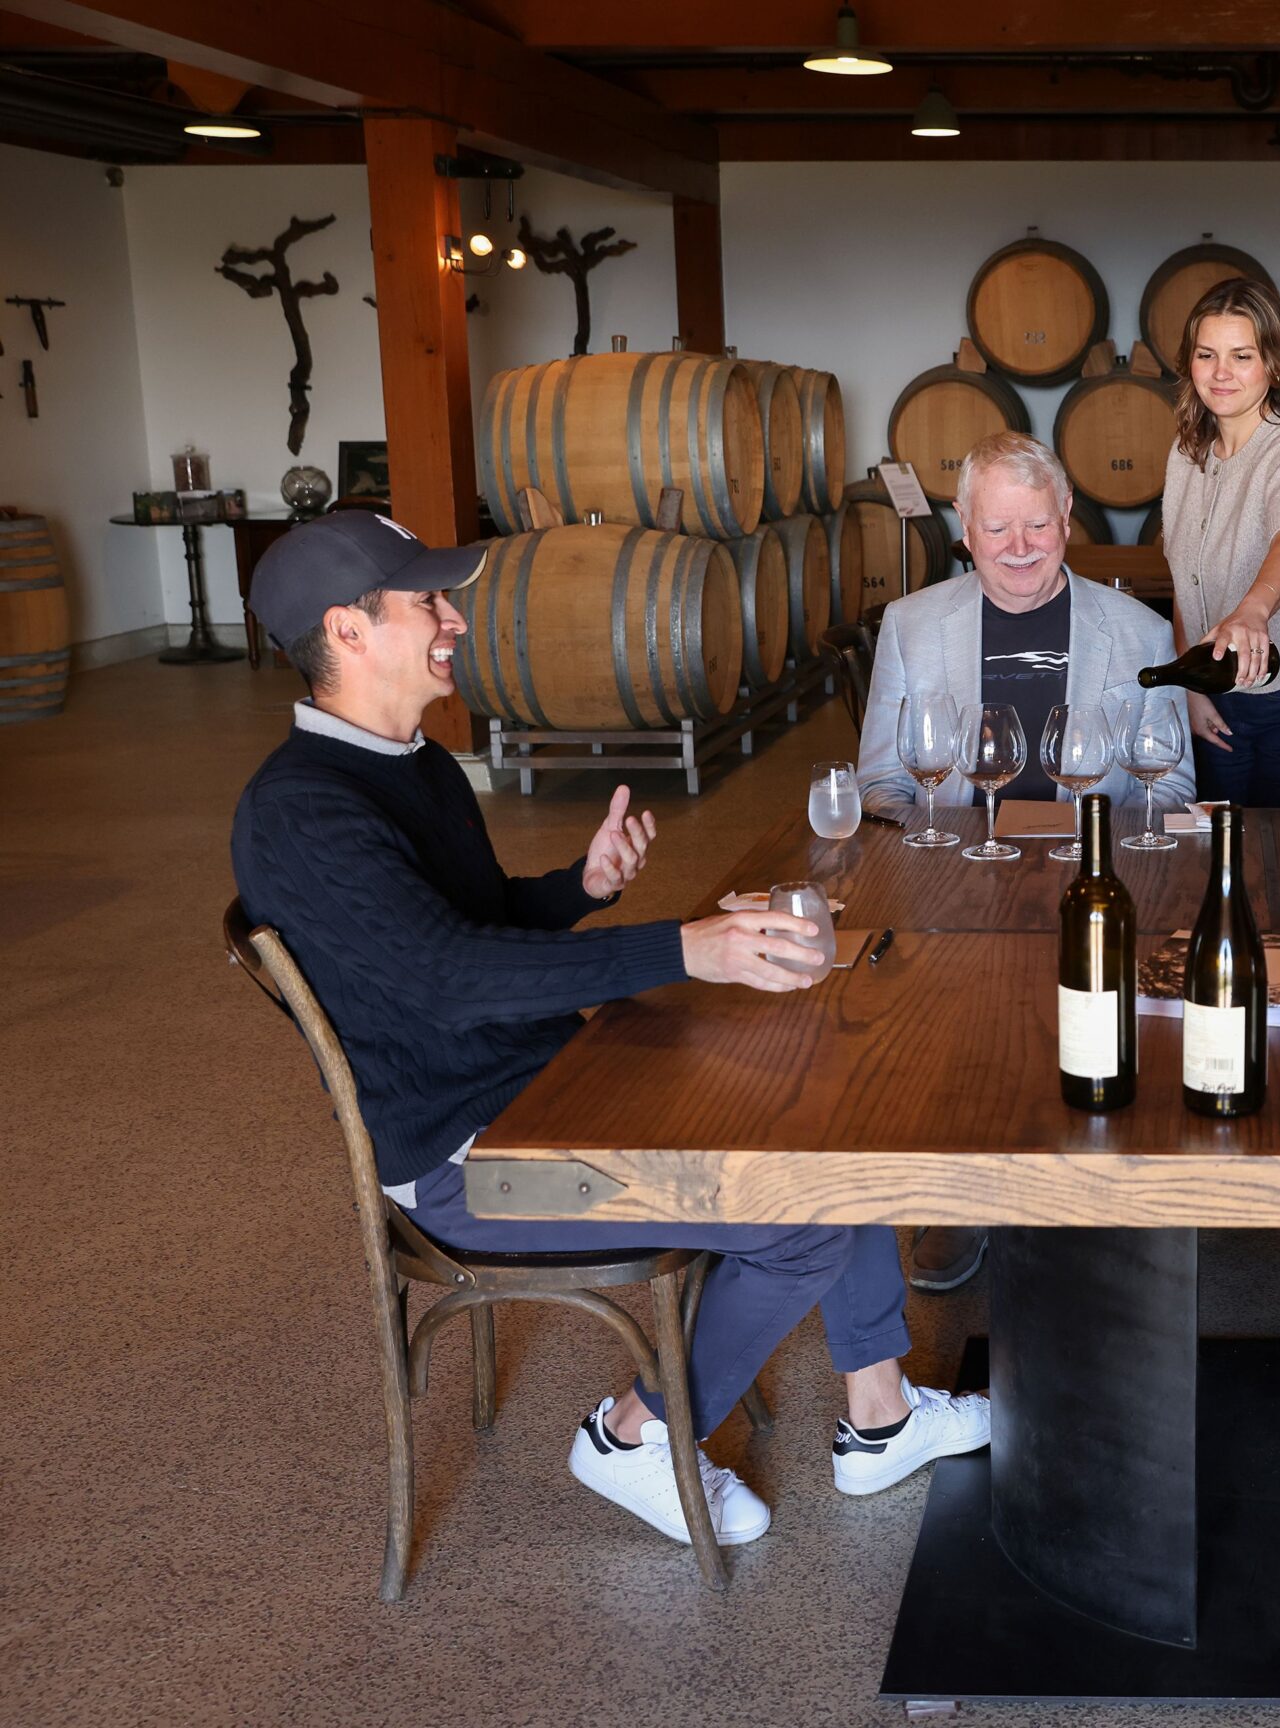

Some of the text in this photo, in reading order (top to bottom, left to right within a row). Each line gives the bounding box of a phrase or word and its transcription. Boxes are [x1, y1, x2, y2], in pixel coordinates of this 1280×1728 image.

[940, 459, 963, 471] 589
[1110, 458, 1134, 471] 686
[863, 577, 886, 589] 564
